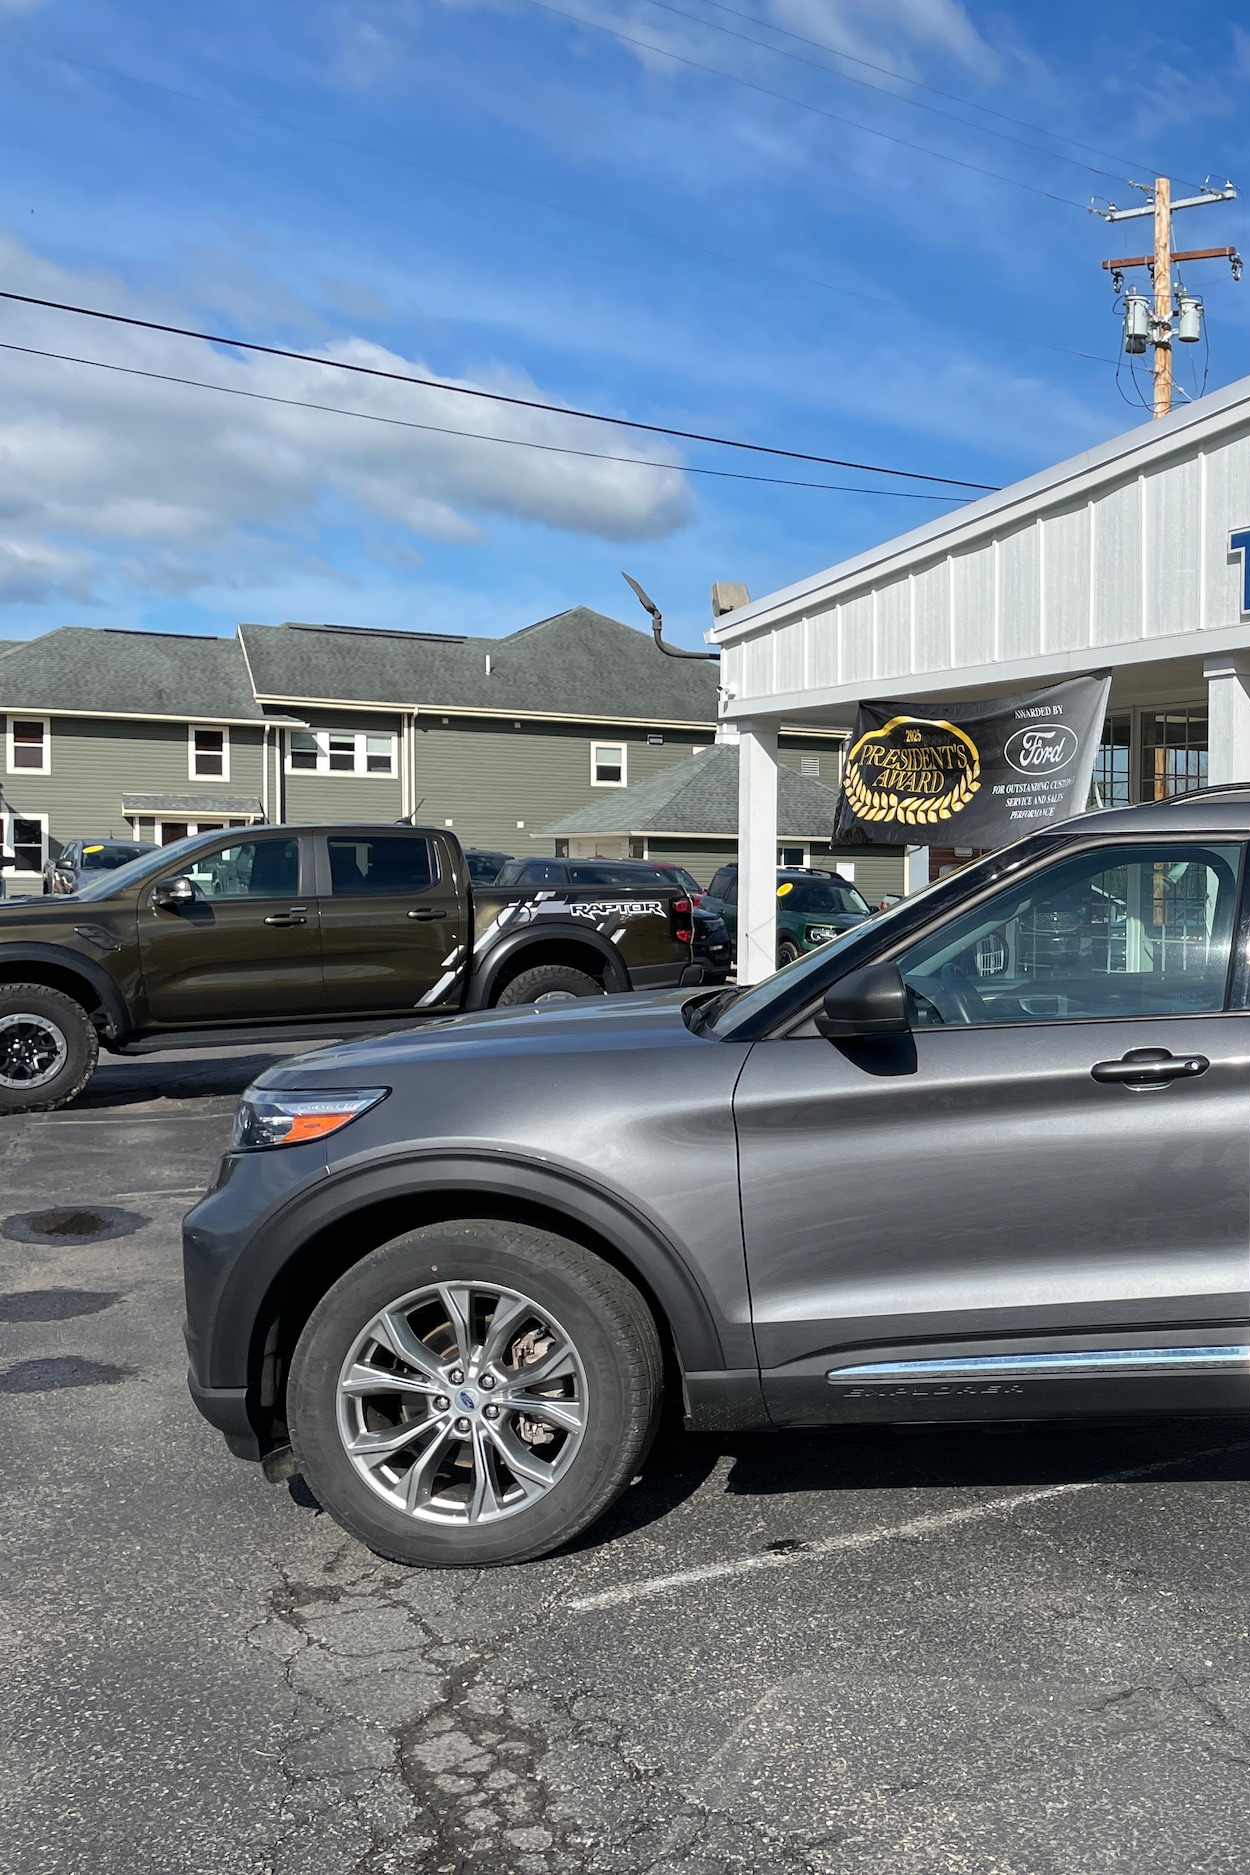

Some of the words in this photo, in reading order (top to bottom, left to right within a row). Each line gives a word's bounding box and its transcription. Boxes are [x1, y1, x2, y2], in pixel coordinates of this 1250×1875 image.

[1014, 706, 1051, 719] AWARDED
[1052, 704, 1063, 715] BY
[906, 729, 922, 743] 2025
[1019, 731, 1065, 767] Ford
[858, 743, 968, 771] PRESIDENT'S
[872, 769, 945, 794] AWARD
[992, 785, 1005, 795] FOR
[1005, 781, 1049, 794] OUTSTANDING
[1005, 796, 1032, 807] SERVICE
[1033, 794, 1046, 805] AND
[1047, 792, 1064, 804] SALES
[1009, 807, 1055, 820] PERFORMANCE
[570, 901, 667, 921] RAPTOR
